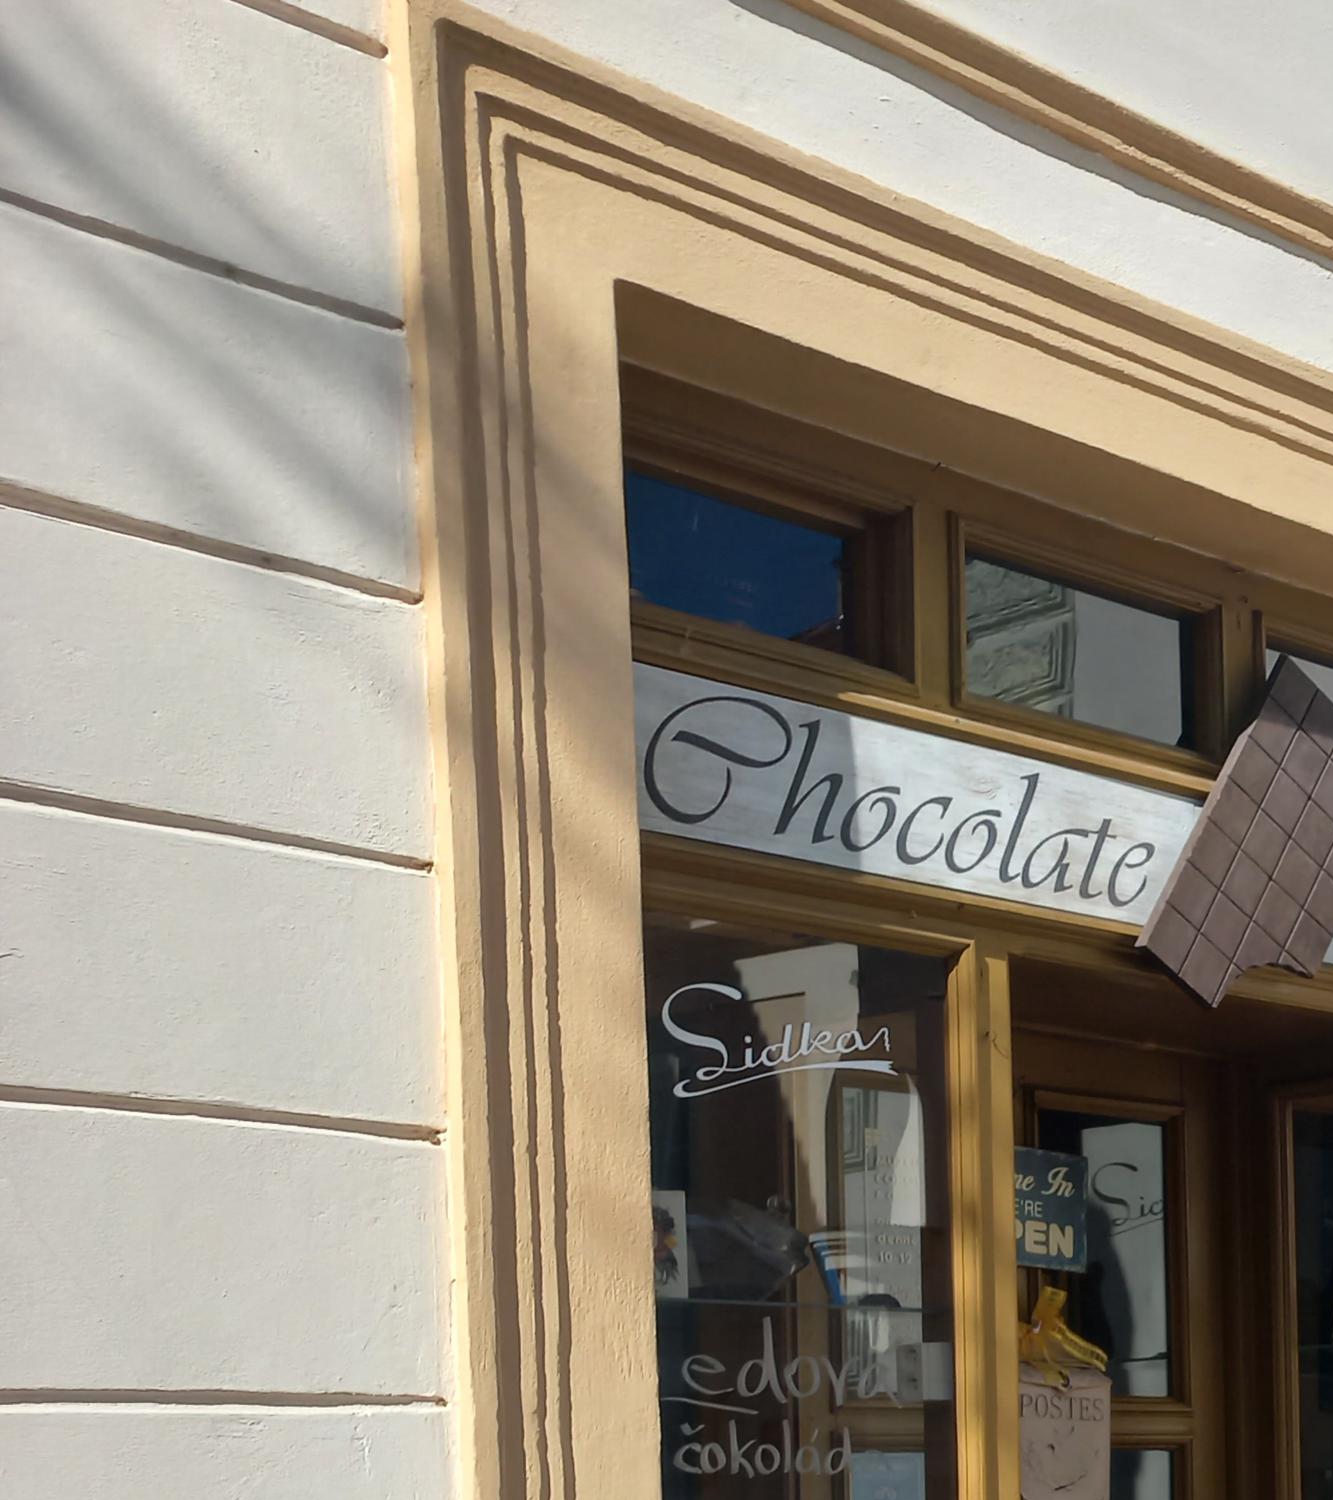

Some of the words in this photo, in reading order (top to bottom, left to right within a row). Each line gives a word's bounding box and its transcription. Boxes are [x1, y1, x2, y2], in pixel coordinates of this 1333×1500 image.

[643, 696, 1155, 908] Chocolate
[1041, 1167, 1075, 1197] In
[1020, 1393, 1104, 1422] POSTES
